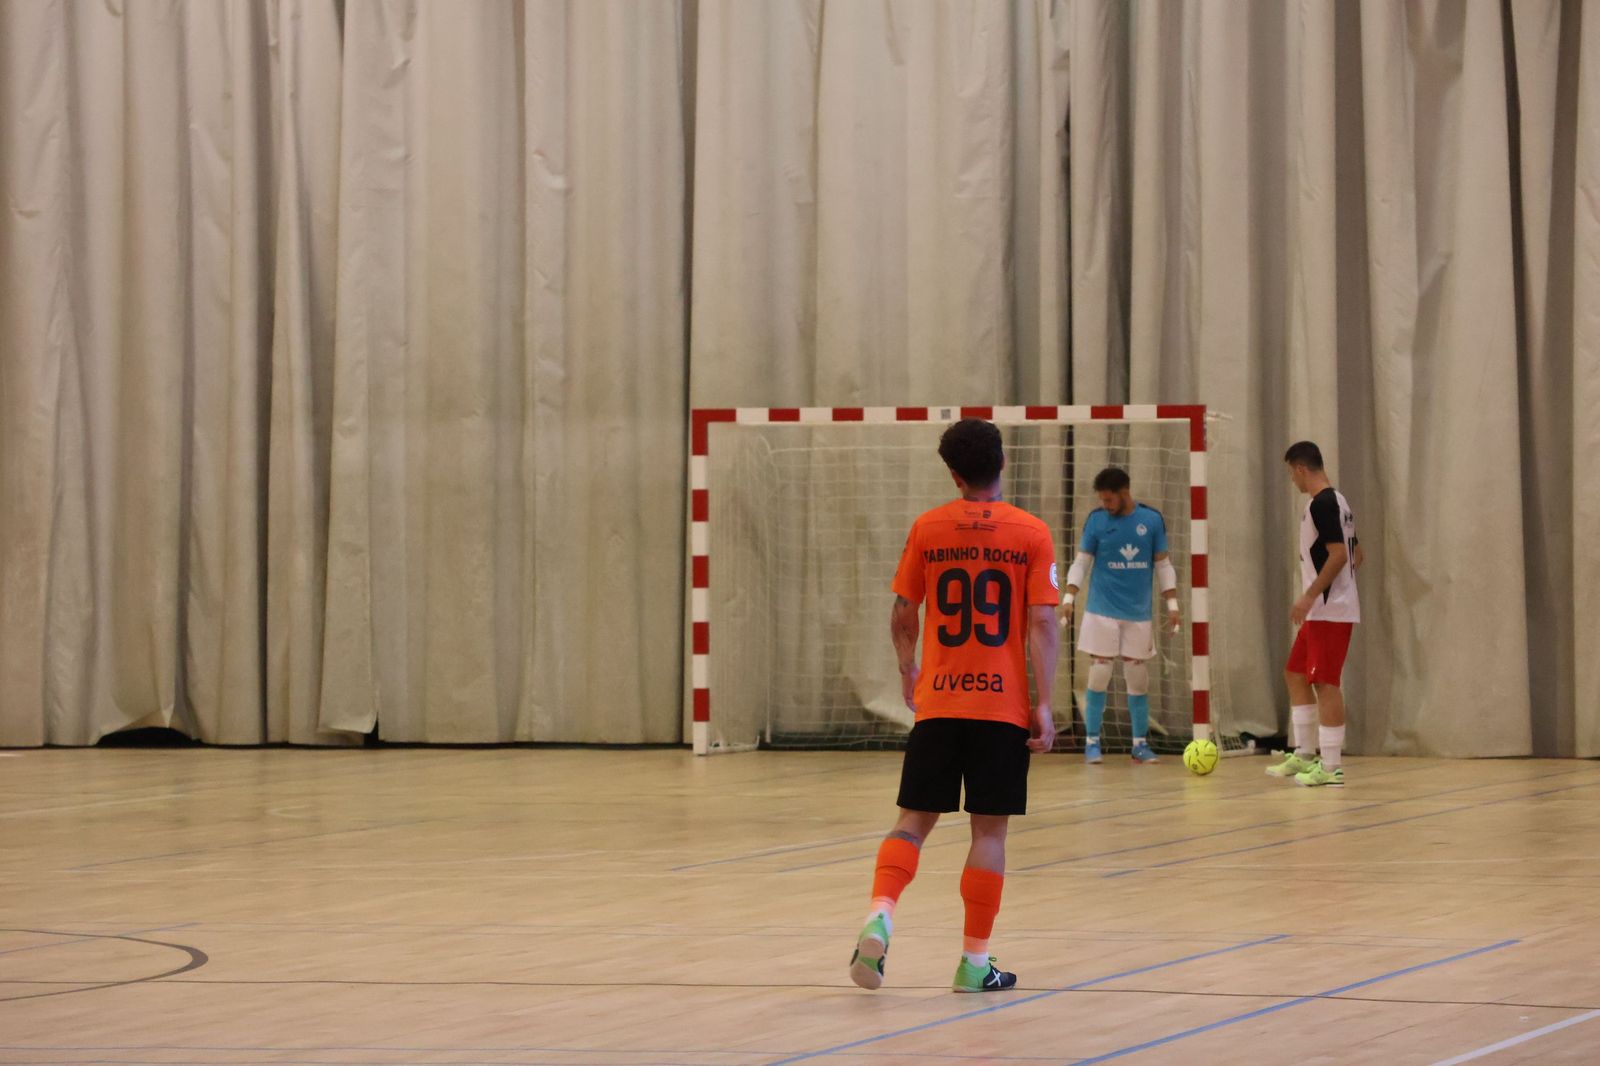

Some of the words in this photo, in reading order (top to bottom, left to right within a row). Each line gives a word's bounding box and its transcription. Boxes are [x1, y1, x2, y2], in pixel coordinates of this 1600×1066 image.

[984, 548, 1028, 565] ROCHA
[937, 568, 1011, 647] 99
[933, 673, 1004, 693] uvesa
